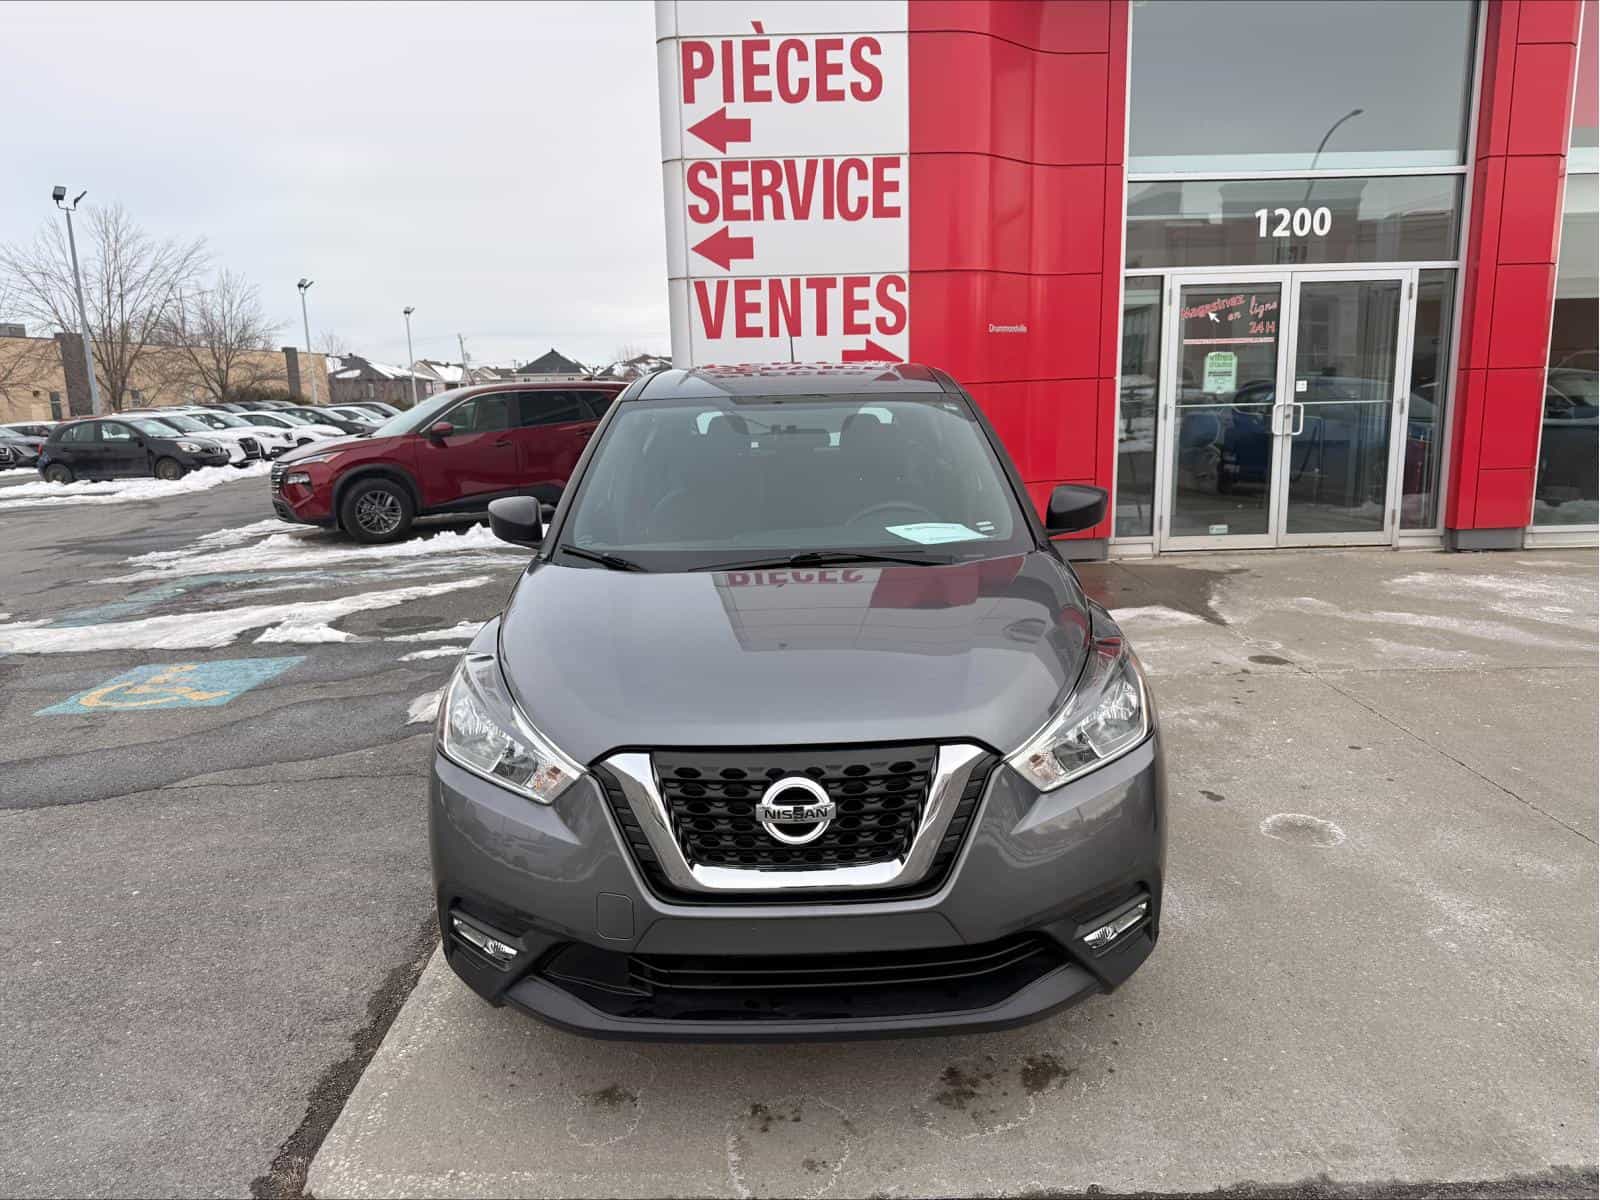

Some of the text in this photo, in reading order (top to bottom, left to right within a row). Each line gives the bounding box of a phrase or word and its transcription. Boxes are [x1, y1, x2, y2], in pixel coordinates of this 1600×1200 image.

[681, 20, 884, 105] PIÈCES
[686, 156, 901, 225] SERVICE
[1254, 206, 1332, 238] 1200
[694, 274, 907, 340] VENTES
[1248, 295, 1278, 319] ligne
[764, 807, 828, 820] NISSAN
